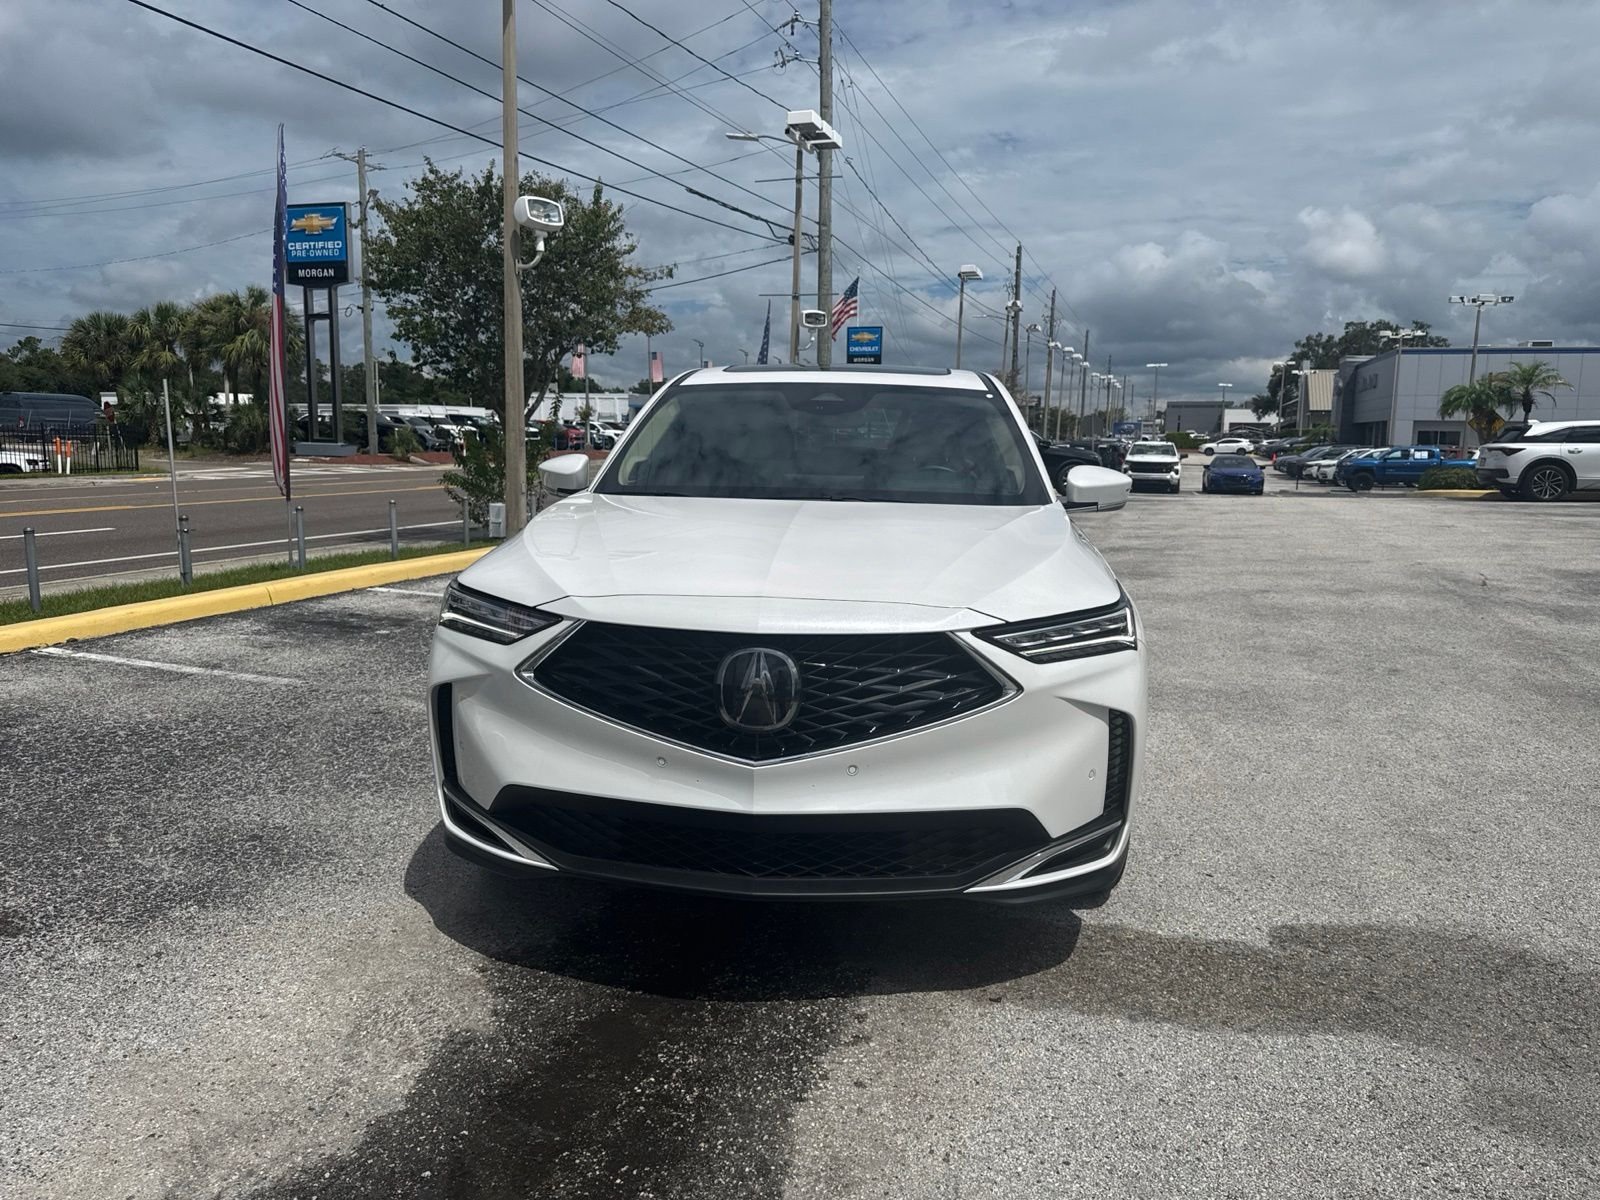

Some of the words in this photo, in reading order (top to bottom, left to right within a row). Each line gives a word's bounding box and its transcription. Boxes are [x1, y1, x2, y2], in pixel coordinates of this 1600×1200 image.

[288, 240, 342, 250] CERTIFIED
[291, 248, 340, 257] PRE-OWNED
[298, 268, 335, 278] MORGAN
